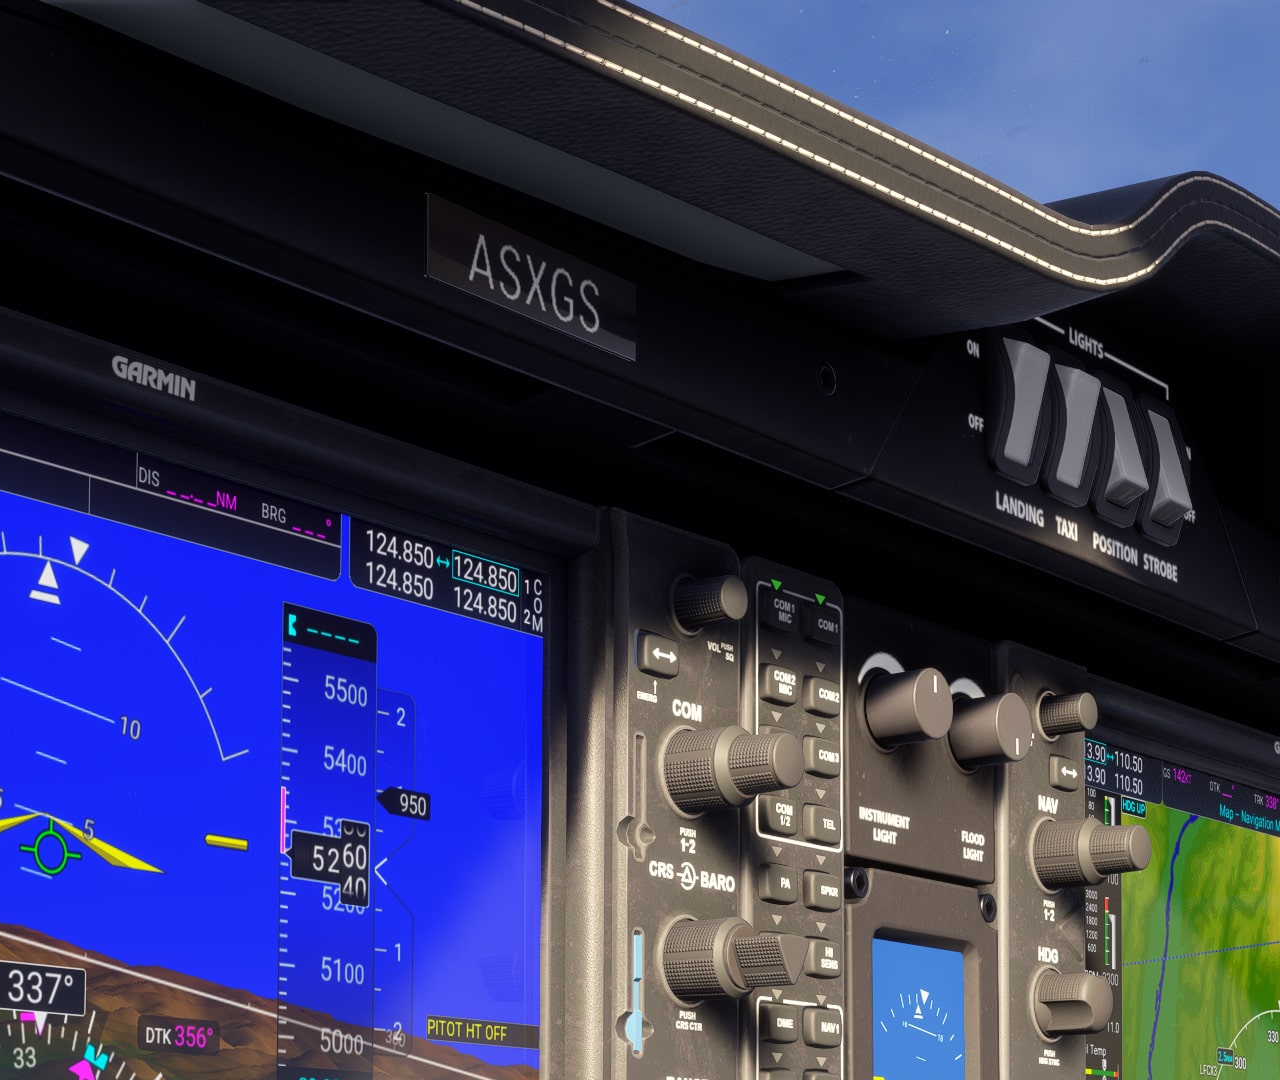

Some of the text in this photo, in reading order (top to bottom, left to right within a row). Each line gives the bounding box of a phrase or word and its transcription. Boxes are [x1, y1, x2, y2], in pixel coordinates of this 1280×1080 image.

[469, 234, 599, 333] ASXGS
[1069, 326, 1103, 359] LIGHTS
[112, 355, 196, 401] GARMIN
[996, 490, 1044, 528] LANDING
[1056, 516, 1078, 542] TAXI
[366, 529, 516, 593] 124.850 124.850
[1093, 531, 1138, 566] POSITION
[1143, 554, 1178, 582] STROBE
[366, 561, 516, 624] 124.850 124.850
[325, 674, 367, 707] 5500
[672, 699, 702, 721] COM
[324, 745, 366, 777] 5400
[400, 793, 426, 816] 950
[859, 806, 910, 829] INSTRUMENT
[1038, 795, 1058, 814] NAV
[1122, 798, 1146, 815] HDG UP
[873, 829, 897, 845] LIGHT
[961, 831, 985, 846] FLOOD
[963, 847, 984, 862] LIGHT
[649, 861, 735, 892] CRS BARO
[1038, 946, 1058, 963] HDG
[321, 956, 364, 985] 5100
[7, 969, 74, 1005] 337°
[145, 1025, 214, 1049] DTK 356°
[427, 1019, 507, 1041] PITOT HT OFF
